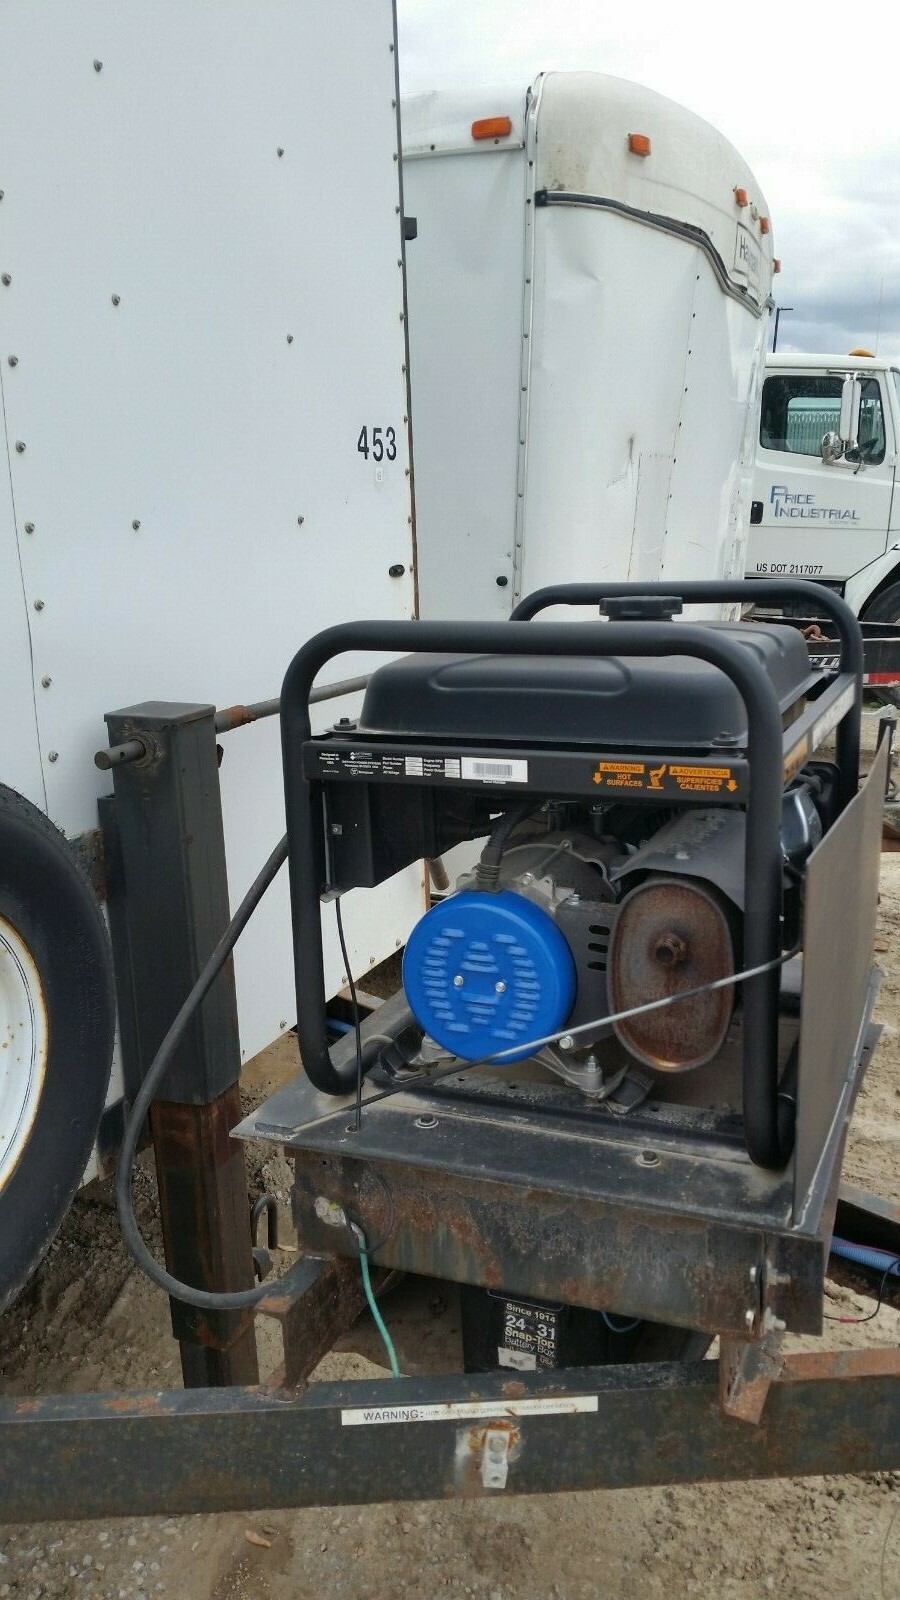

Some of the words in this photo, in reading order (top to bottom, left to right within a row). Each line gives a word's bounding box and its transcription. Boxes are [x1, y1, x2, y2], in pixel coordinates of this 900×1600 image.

[357, 425, 397, 462] 453
[770, 485, 816, 504] PRICE
[774, 499, 861, 520] INDUSTRIAL
[756, 563, 768, 572] US
[770, 564, 788, 573] DOT
[789, 564, 823, 575] 2117077
[608, 764, 642, 772] WARNING
[678, 768, 729, 777] ADVERTENCIA
[606, 779, 643, 787] SURFACES
[676, 777, 723, 786] SUPERFICIES
[680, 784, 720, 792] CALIENTES
[506, 1303, 532, 1317] Since
[534, 1311, 556, 1324] 1914
[505, 1314, 526, 1331] 24
[536, 1323, 556, 1340] 31
[504, 1326, 556, 1349] Snap-Top
[504, 1336, 536, 1352] Battery
[537, 1345, 556, 1358] Box
[363, 1409, 424, 1421] WARNING:
